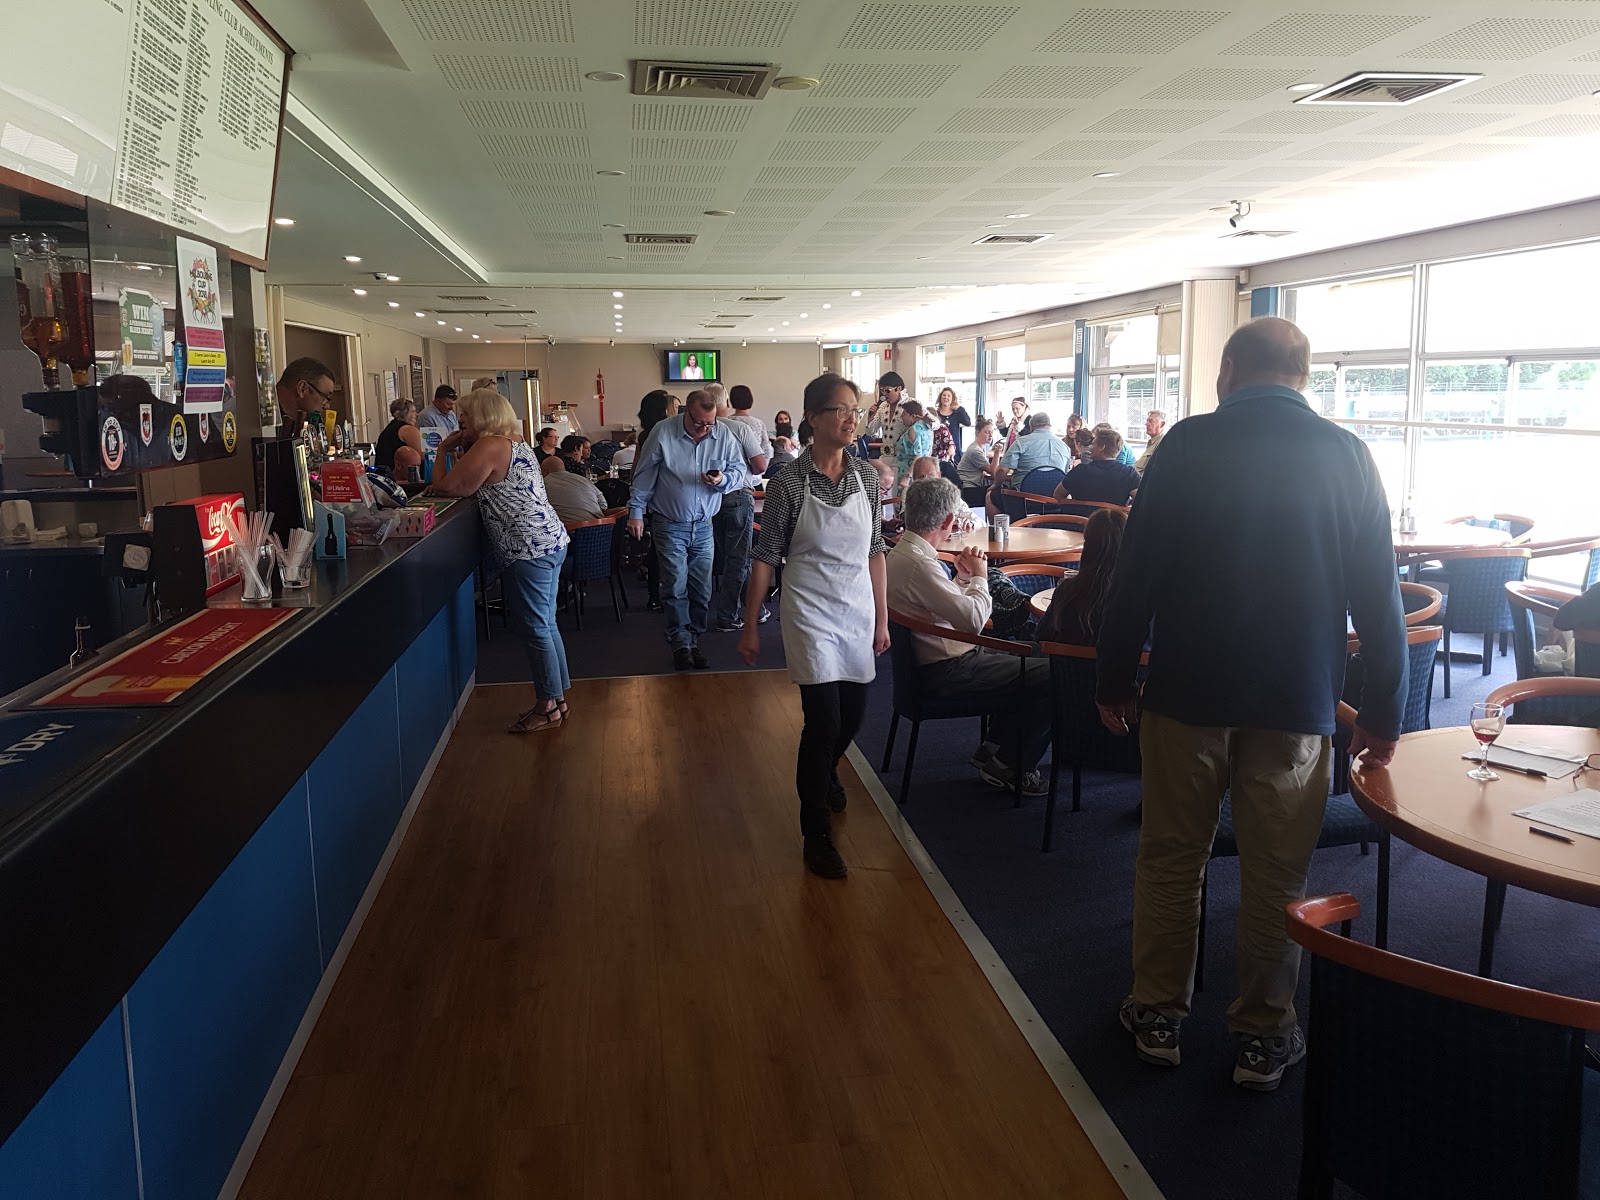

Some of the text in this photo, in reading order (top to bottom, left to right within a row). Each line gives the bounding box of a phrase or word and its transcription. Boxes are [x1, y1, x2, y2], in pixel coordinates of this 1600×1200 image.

[224, 8, 238, 31] CLUB
[238, 23, 274, 65] ACHIEVEMENTS
[189, 269, 213, 282] MELBOURNE
[197, 280, 207, 289] CUP
[132, 304, 150, 321] WIN
[3, 723, 76, 752] DRY
